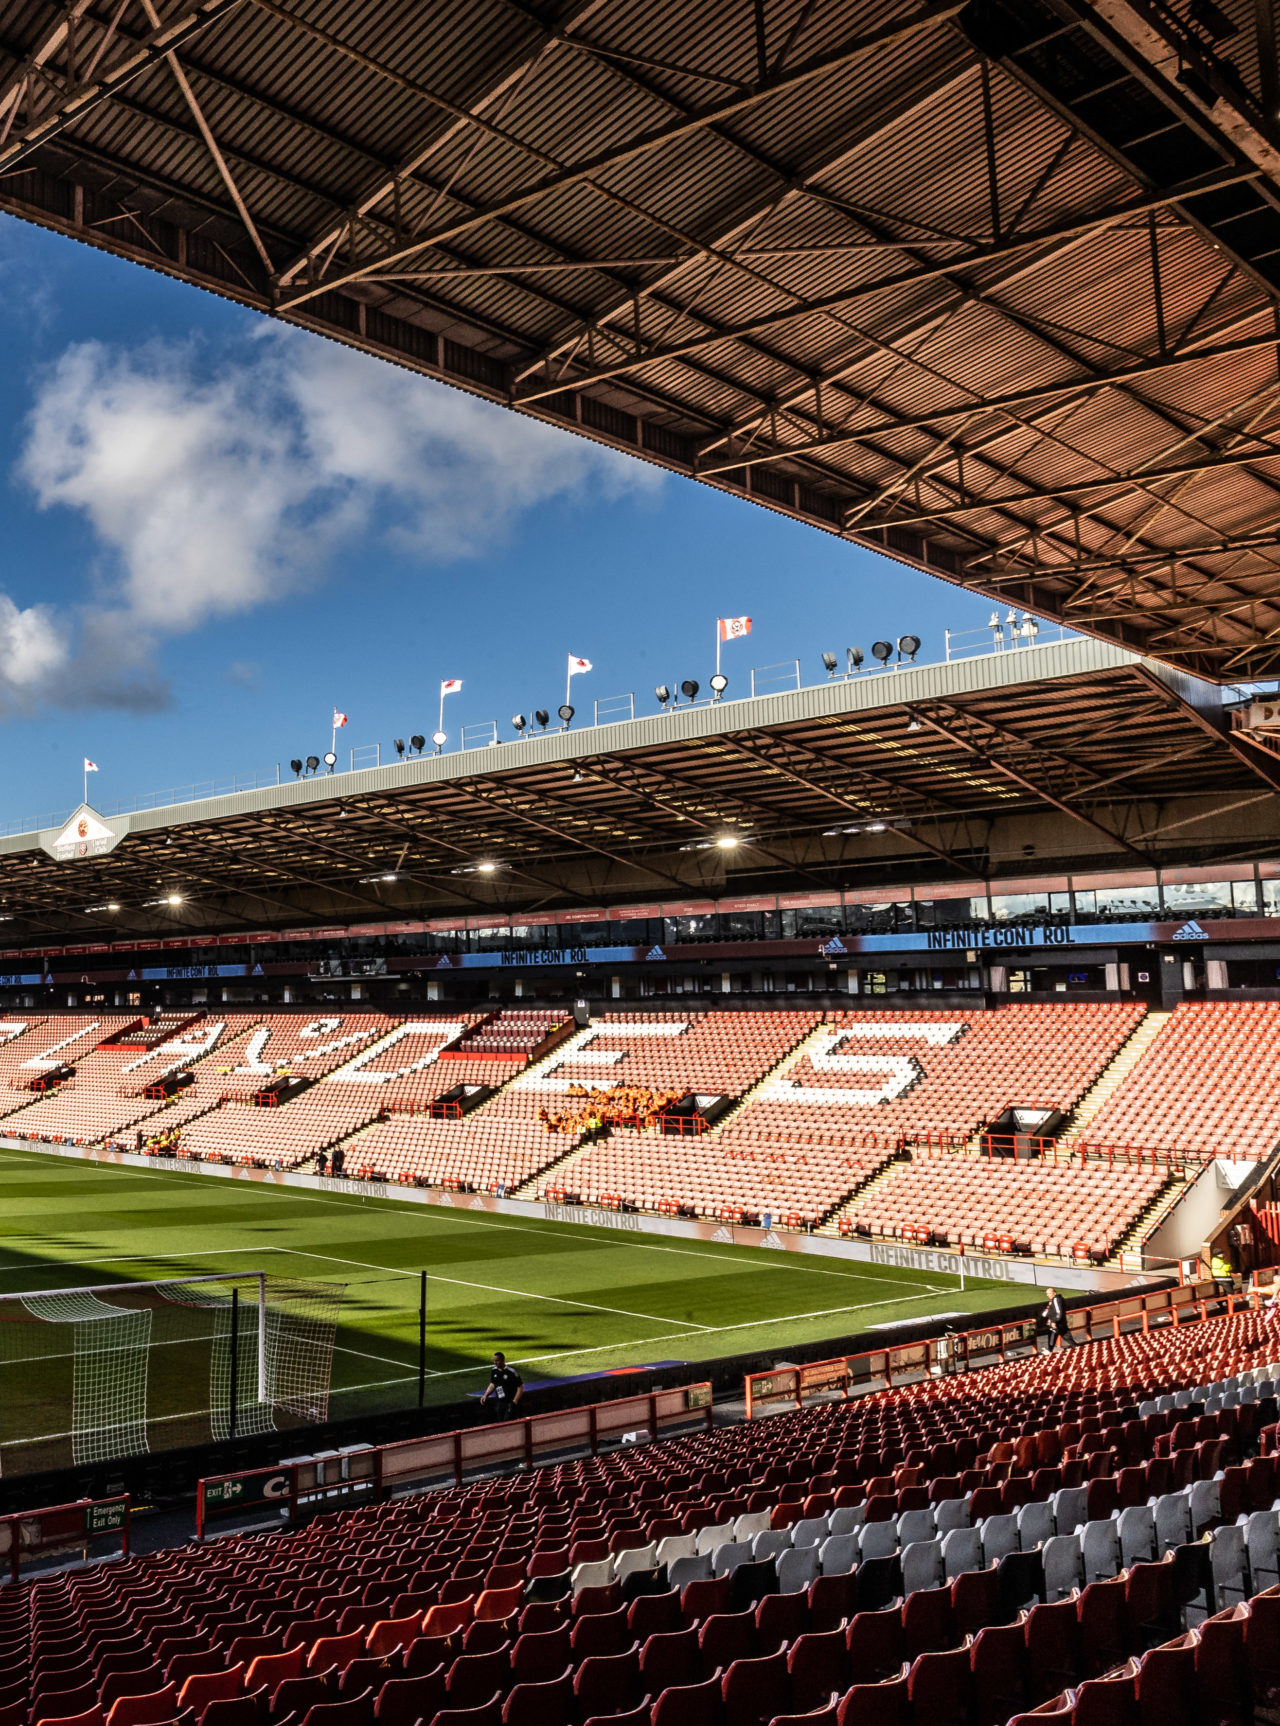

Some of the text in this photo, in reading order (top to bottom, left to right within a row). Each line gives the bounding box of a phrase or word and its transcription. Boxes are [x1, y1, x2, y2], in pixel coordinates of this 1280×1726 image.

[1264, 706, 1280, 720] D
[927, 931, 991, 948] INFINITE
[1172, 932, 1209, 940] adidas
[501, 951, 539, 965] INFINITE
[319, 1177, 389, 1197] INFINITE CONTROL
[545, 1205, 642, 1231] INFINITE CONTROL
[870, 1245, 1015, 1280] INFINITE CONTROL
[207, 1486, 223, 1498] EXIT
[93, 1504, 126, 1516] Emergency
[93, 1515, 121, 1528] Exit Only
